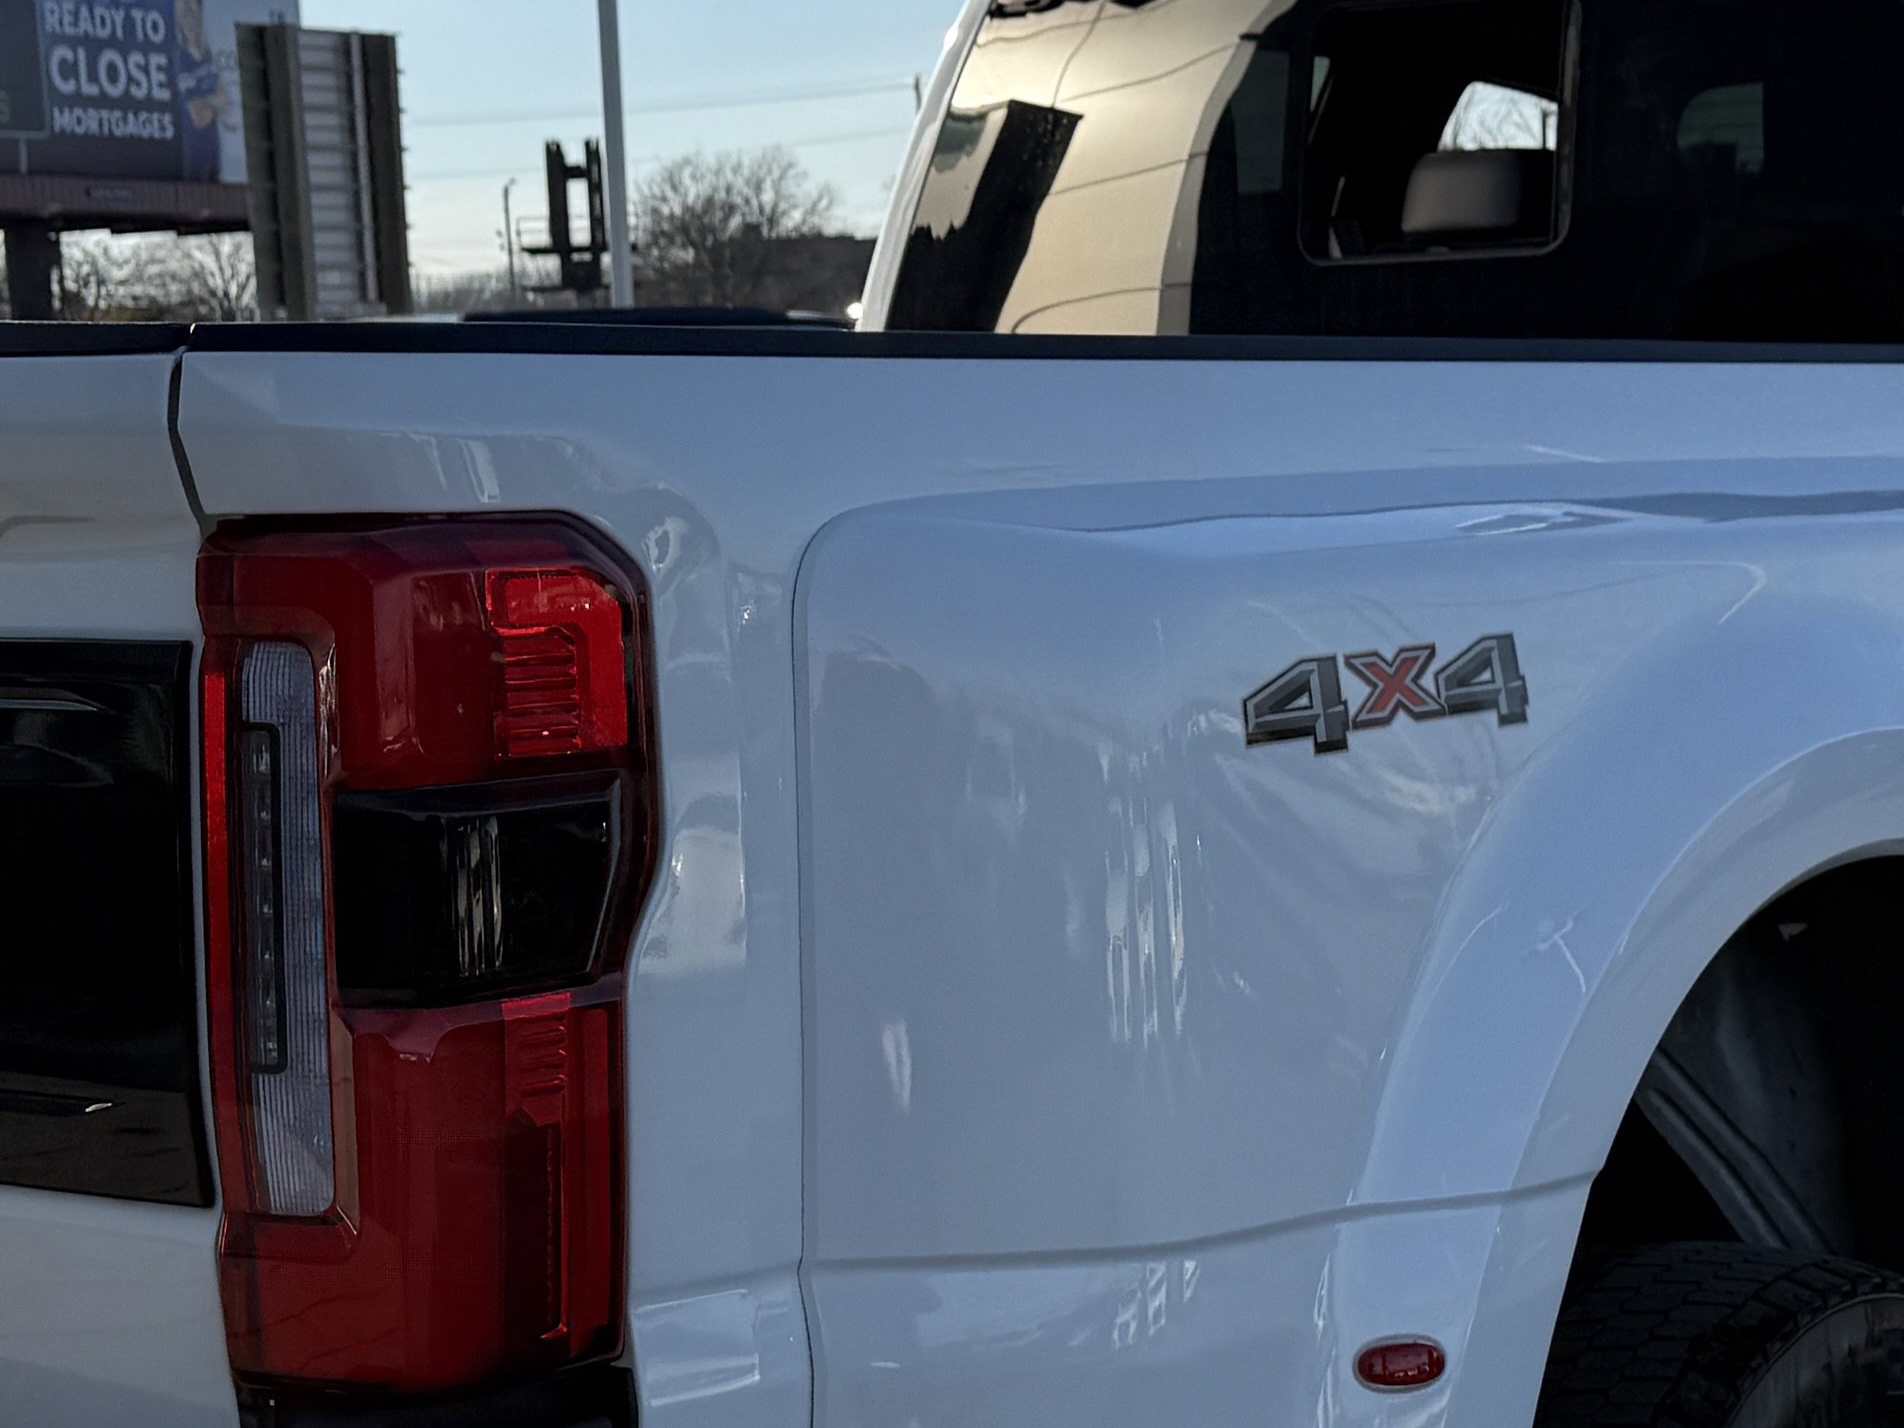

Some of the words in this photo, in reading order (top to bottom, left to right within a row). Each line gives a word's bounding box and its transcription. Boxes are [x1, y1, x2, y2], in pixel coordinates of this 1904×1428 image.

[43, 1, 124, 40] READY
[129, 9, 166, 42] TO
[48, 48, 172, 101] CLOSE
[53, 107, 174, 140] MORTGAGES
